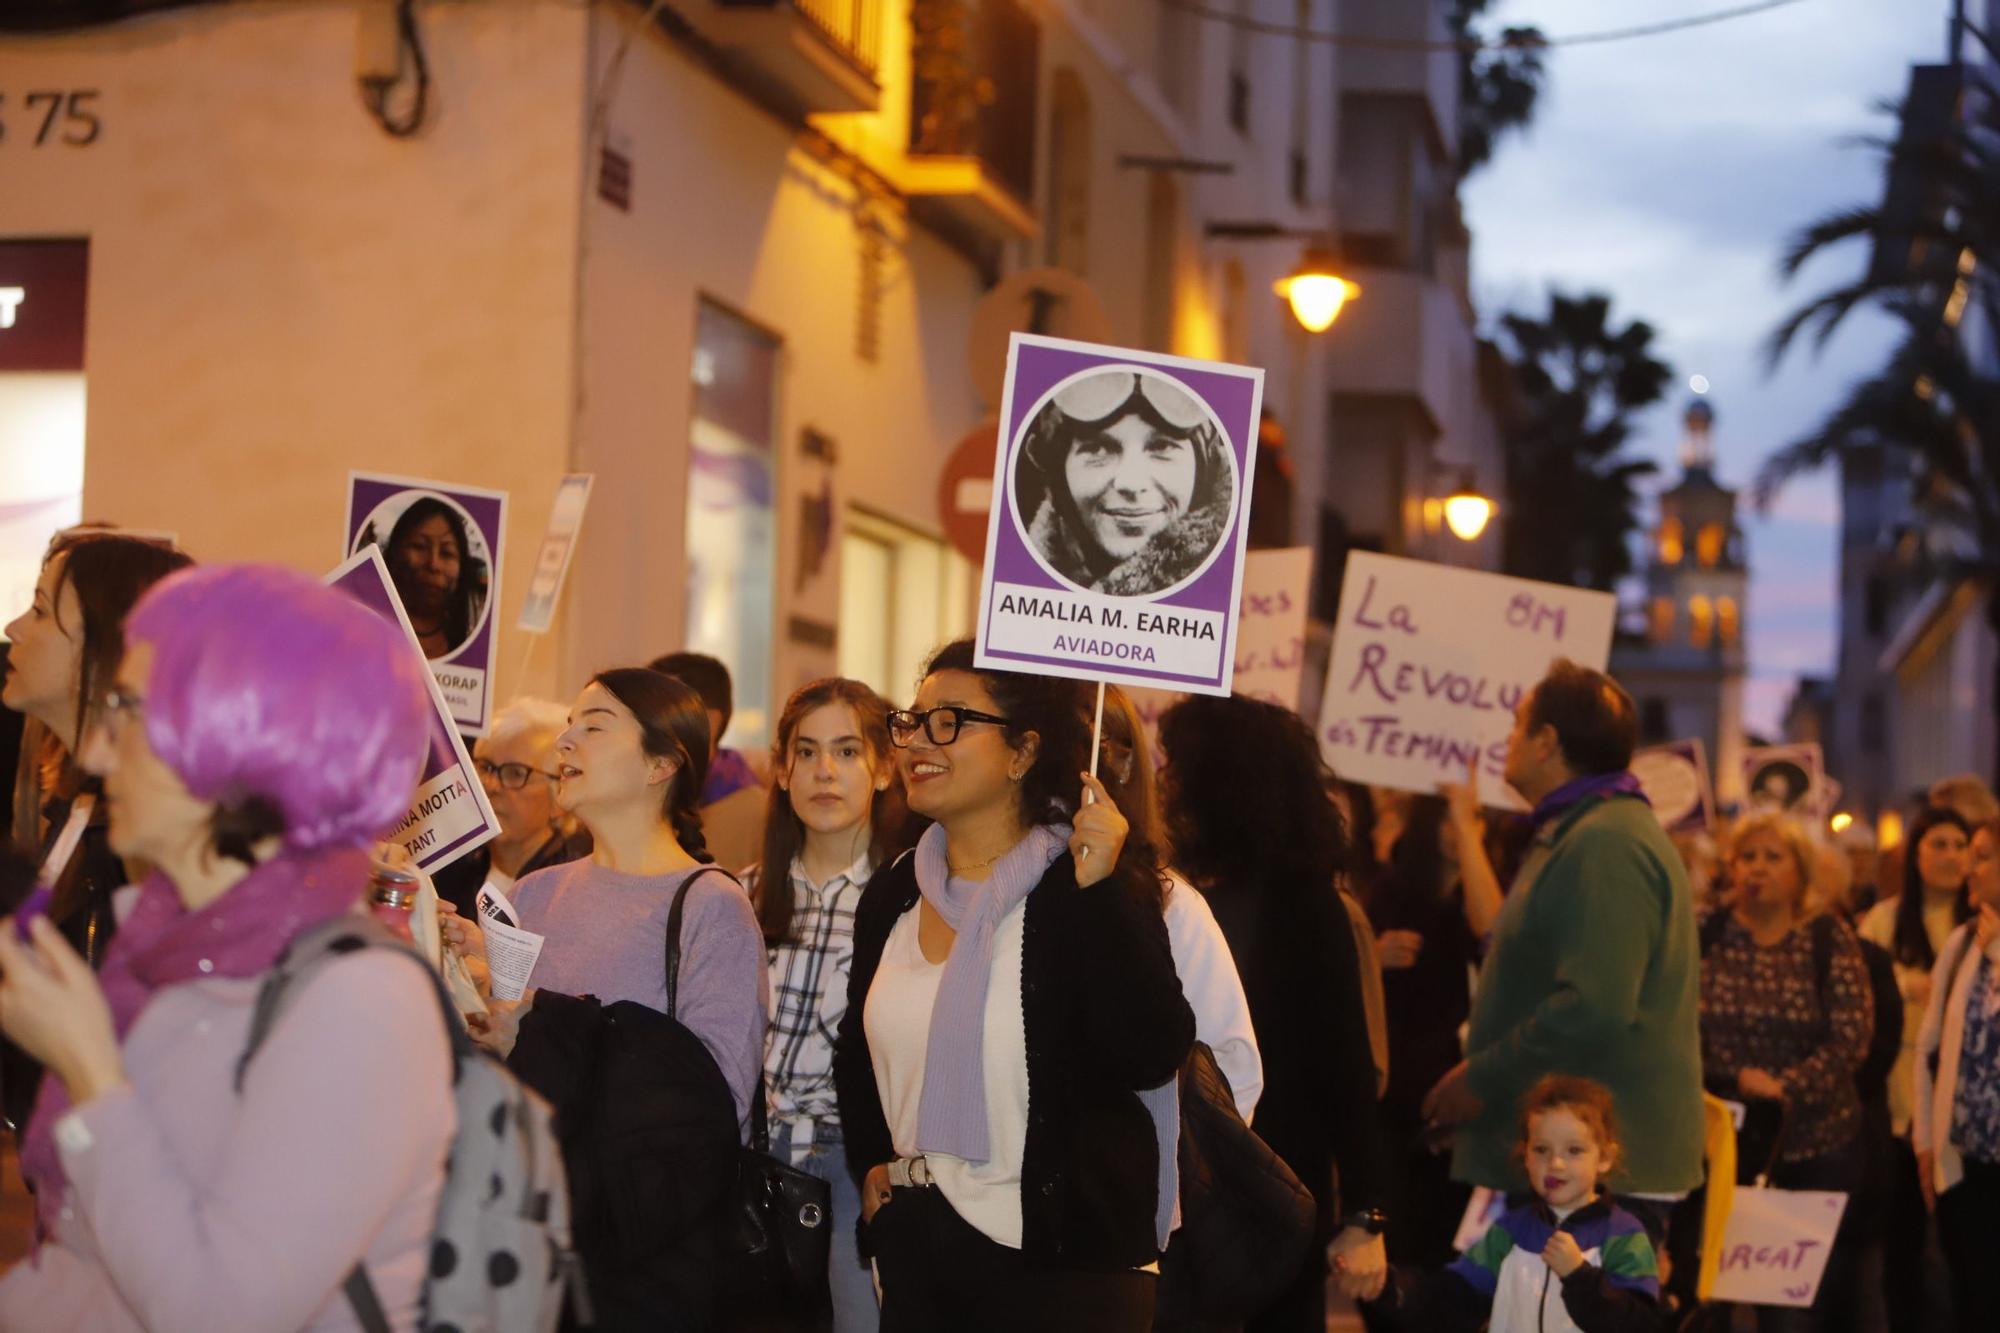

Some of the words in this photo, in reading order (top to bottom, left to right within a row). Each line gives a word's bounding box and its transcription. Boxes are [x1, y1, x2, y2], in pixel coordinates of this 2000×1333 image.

[26, 90, 101, 148] 75
[1000, 595, 1093, 624] AMALIA
[1101, 608, 1128, 629] M.
[1137, 613, 1215, 640] EARHA
[1354, 575, 1417, 634] La
[1507, 593, 1566, 641] 8M
[1053, 635, 1156, 663] AVIADORA
[1350, 643, 1522, 710] REVOLU
[418, 780, 467, 819] MOTTA
[404, 828, 436, 857] TANT
